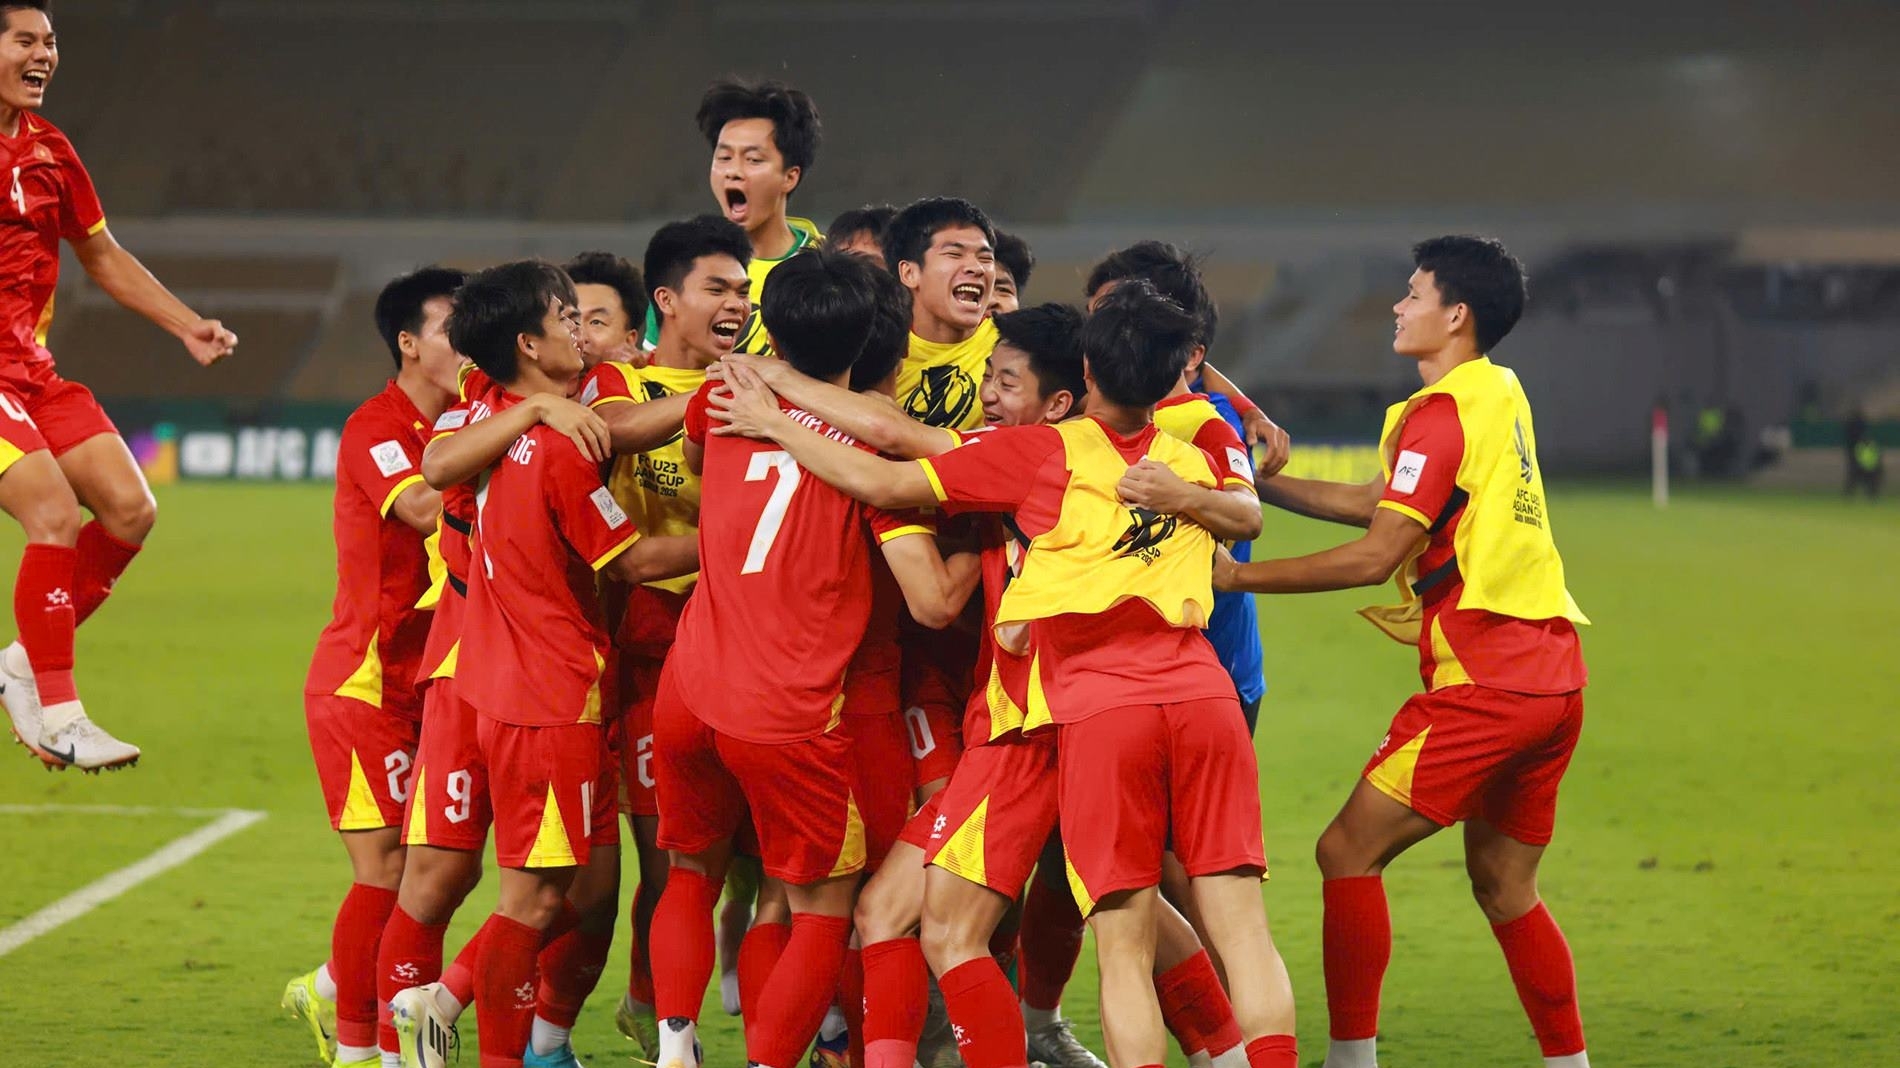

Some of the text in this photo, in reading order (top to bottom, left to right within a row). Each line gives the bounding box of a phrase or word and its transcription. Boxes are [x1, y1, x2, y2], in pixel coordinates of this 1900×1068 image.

[10, 166, 26, 215] 4
[653, 459, 679, 474] U23
[656, 473, 685, 488] CUP
[1516, 487, 1529, 502] AFC
[740, 450, 801, 576] 7
[444, 769, 472, 824] 9
